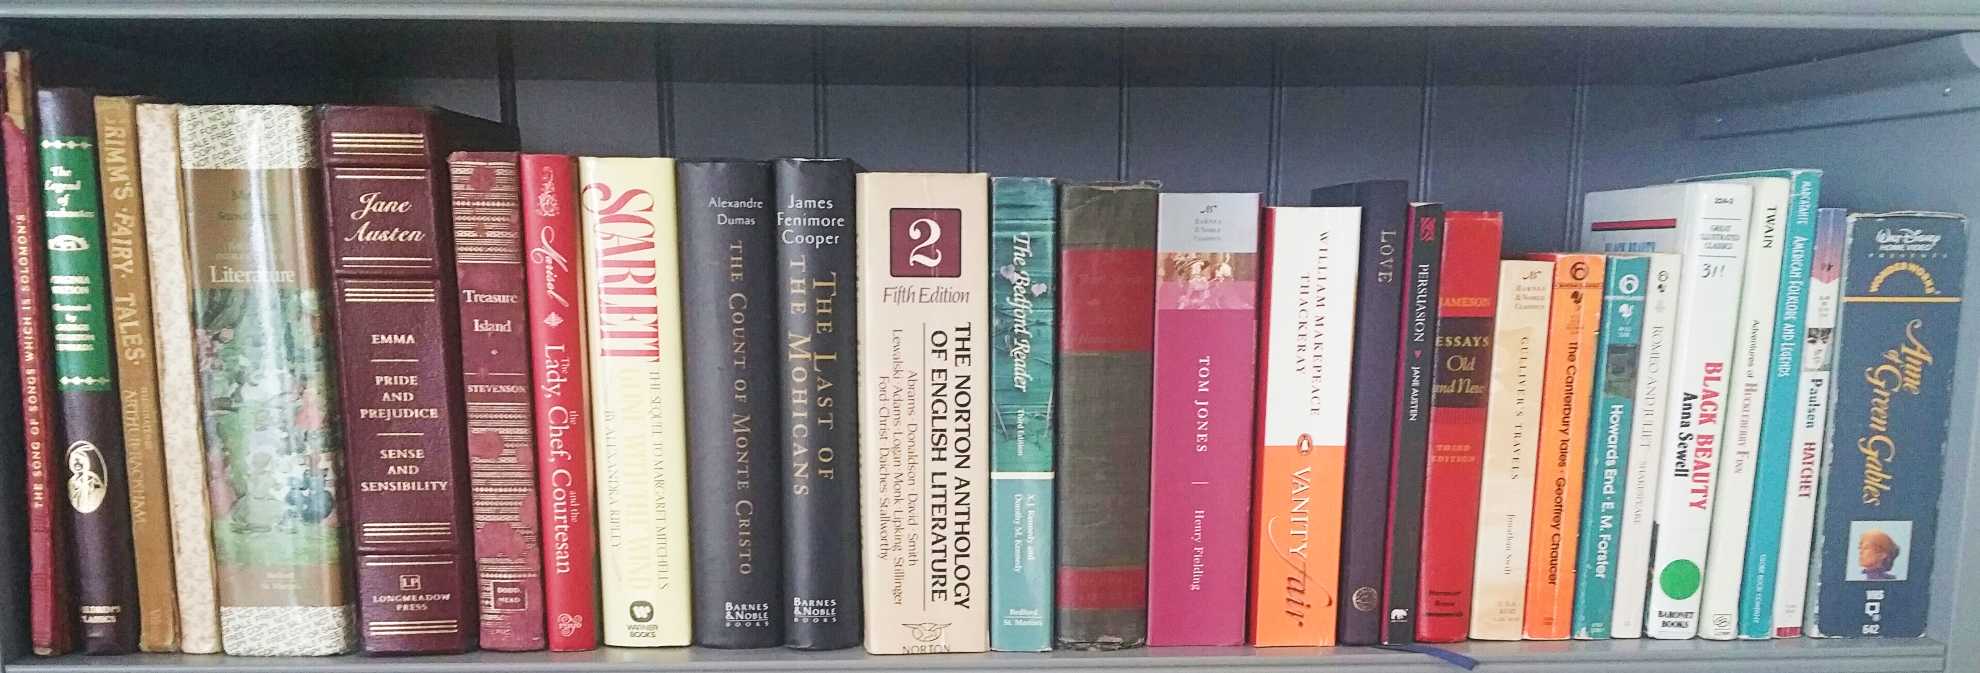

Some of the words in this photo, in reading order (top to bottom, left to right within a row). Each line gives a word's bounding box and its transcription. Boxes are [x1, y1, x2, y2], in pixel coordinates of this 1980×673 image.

[351, 192, 412, 220] Jane
[708, 197, 764, 210] Alexandre
[717, 214, 757, 226] Dumas
[777, 212, 845, 228] Fenimore
[787, 195, 834, 210] James
[344, 221, 426, 242] Austen
[781, 230, 840, 249] Cooper
[908, 218, 942, 267] 2
[1762, 207, 1777, 249] TWAIN
[729, 240, 743, 282] THE
[1012, 232, 1032, 267] The
[1378, 229, 1397, 283] LOVE
[1788, 236, 1809, 281] AMERICAN
[208, 265, 295, 284] Literature
[581, 182, 660, 363] SCARLETT
[789, 255, 806, 315] THE
[1316, 231, 1329, 308] WILLIAM
[21, 299, 32, 310] IS
[463, 290, 518, 304] Treasure
[812, 272, 837, 335] THE
[882, 285, 915, 307] Fifth
[918, 286, 970, 304] Edition
[1006, 271, 1033, 339] Bedford
[1413, 264, 1430, 342] PERSUASION
[1783, 280, 1803, 324] FOLKLORE
[22, 317, 35, 361] WHICH
[371, 334, 415, 344] EMMA
[473, 319, 512, 333] Island
[728, 293, 748, 369] COUNT
[1296, 274, 1310, 374] THACKERAY
[1435, 336, 1489, 348] ESSAYS
[1781, 323, 1796, 342] AND
[892, 328, 905, 379] Lewalski
[930, 330, 948, 362] OF
[954, 321, 971, 367] THE
[1567, 341, 1578, 363] The
[1777, 341, 1794, 378] LEGENDS
[1901, 319, 1934, 395] Anne
[375, 375, 418, 386] PRIDE
[541, 344, 567, 399] Lady,
[559, 356, 570, 374] The
[649, 370, 661, 391] THE
[1010, 338, 1033, 392] Reader
[1198, 356, 1210, 392] TOM
[1310, 315, 1325, 416] MAKEPEACE
[1409, 366, 1421, 387] JANE
[1446, 354, 1476, 372] Old
[26, 369, 40, 412] SONGS
[382, 392, 414, 402] AND
[467, 384, 526, 394] STEVENSON
[734, 379, 747, 405] OF
[814, 352, 837, 430] LAST
[879, 376, 890, 401] Ford
[893, 385, 904, 427] Adams
[907, 370, 919, 416] Abrams
[1408, 387, 1419, 421] AUSTEN
[1560, 364, 1578, 436] Canterbury
[1645, 375, 1658, 407] AND
[1698, 362, 1723, 427] BLACK
[1805, 378, 1824, 428] Paulsen
[1865, 364, 1903, 432] Green
[30, 420, 40, 436] OF
[360, 408, 439, 420] PREJUDICE
[569, 410, 580, 425] the
[648, 395, 664, 436] SEQUEL
[788, 331, 812, 496] MOHICANS
[879, 406, 890, 441] Christ
[930, 368, 948, 462] ENGLISH
[954, 375, 972, 469] NORTON
[1195, 400, 1209, 452] JONES
[1640, 408, 1654, 448] JULIET
[1679, 392, 1698, 429] Anna
[547, 405, 572, 463] Chef,
[651, 442, 664, 458] TO
[732, 414, 751, 489] MONTE
[889, 431, 904, 467] Logan
[1602, 404, 1625, 469] Howards
[31, 441, 44, 472] SONG
[380, 449, 425, 459] SENSE
[387, 465, 419, 475] AND
[817, 447, 834, 480] OF
[879, 447, 890, 493] Daiches
[907, 423, 919, 486] Donaldson
[1511, 425, 1523, 480] TRAVELS
[1557, 438, 1569, 468] Tales
[1674, 432, 1693, 478] Sewell
[1798, 441, 1816, 498] HATCHET
[1857, 434, 1896, 507] Gables
[361, 481, 448, 492] SENSIBILITY
[893, 472, 904, 505] Monk
[1602, 469, 1618, 495] End
[1689, 433, 1715, 511] BEAUTY
[32, 482, 44, 508] THE
[568, 490, 578, 507] and
[652, 460, 666, 522] MARGARET
[906, 492, 919, 526] David
[1013, 494, 1024, 524] Dorothy
[1549, 477, 1567, 531] Geoffrey
[1601, 503, 1614, 514] E.
[551, 469, 572, 574] Courtesan
[570, 507, 581, 524] the
[878, 497, 890, 560] Stallworthy
[1025, 509, 1036, 543] Kennedy
[1191, 510, 1205, 543] Henry
[1288, 466, 1313, 559] VANITY
[1599, 515, 1614, 532] M.
[735, 500, 754, 576] CRISTO
[889, 510, 905, 552] Lipking
[930, 472, 948, 602] LITERATURE
[953, 476, 971, 609] ANTHOLOGY
[906, 532, 919, 567] Smith
[1013, 539, 1024, 572] Kennedy
[1027, 545, 1035, 560] and
[1547, 533, 1562, 586] Chaucer
[1595, 533, 1612, 578] Forster
[893, 557, 906, 607] Stillinger
[1190, 547, 1204, 591] Fielding
[373, 593, 451, 602] LONGMEADOW
[396, 603, 427, 611] PRESS
[725, 602, 769, 611] BARNES
[793, 597, 837, 607] BARNES
[1658, 610, 1696, 620] BARONET
[1661, 619, 1689, 629] BOOKS
